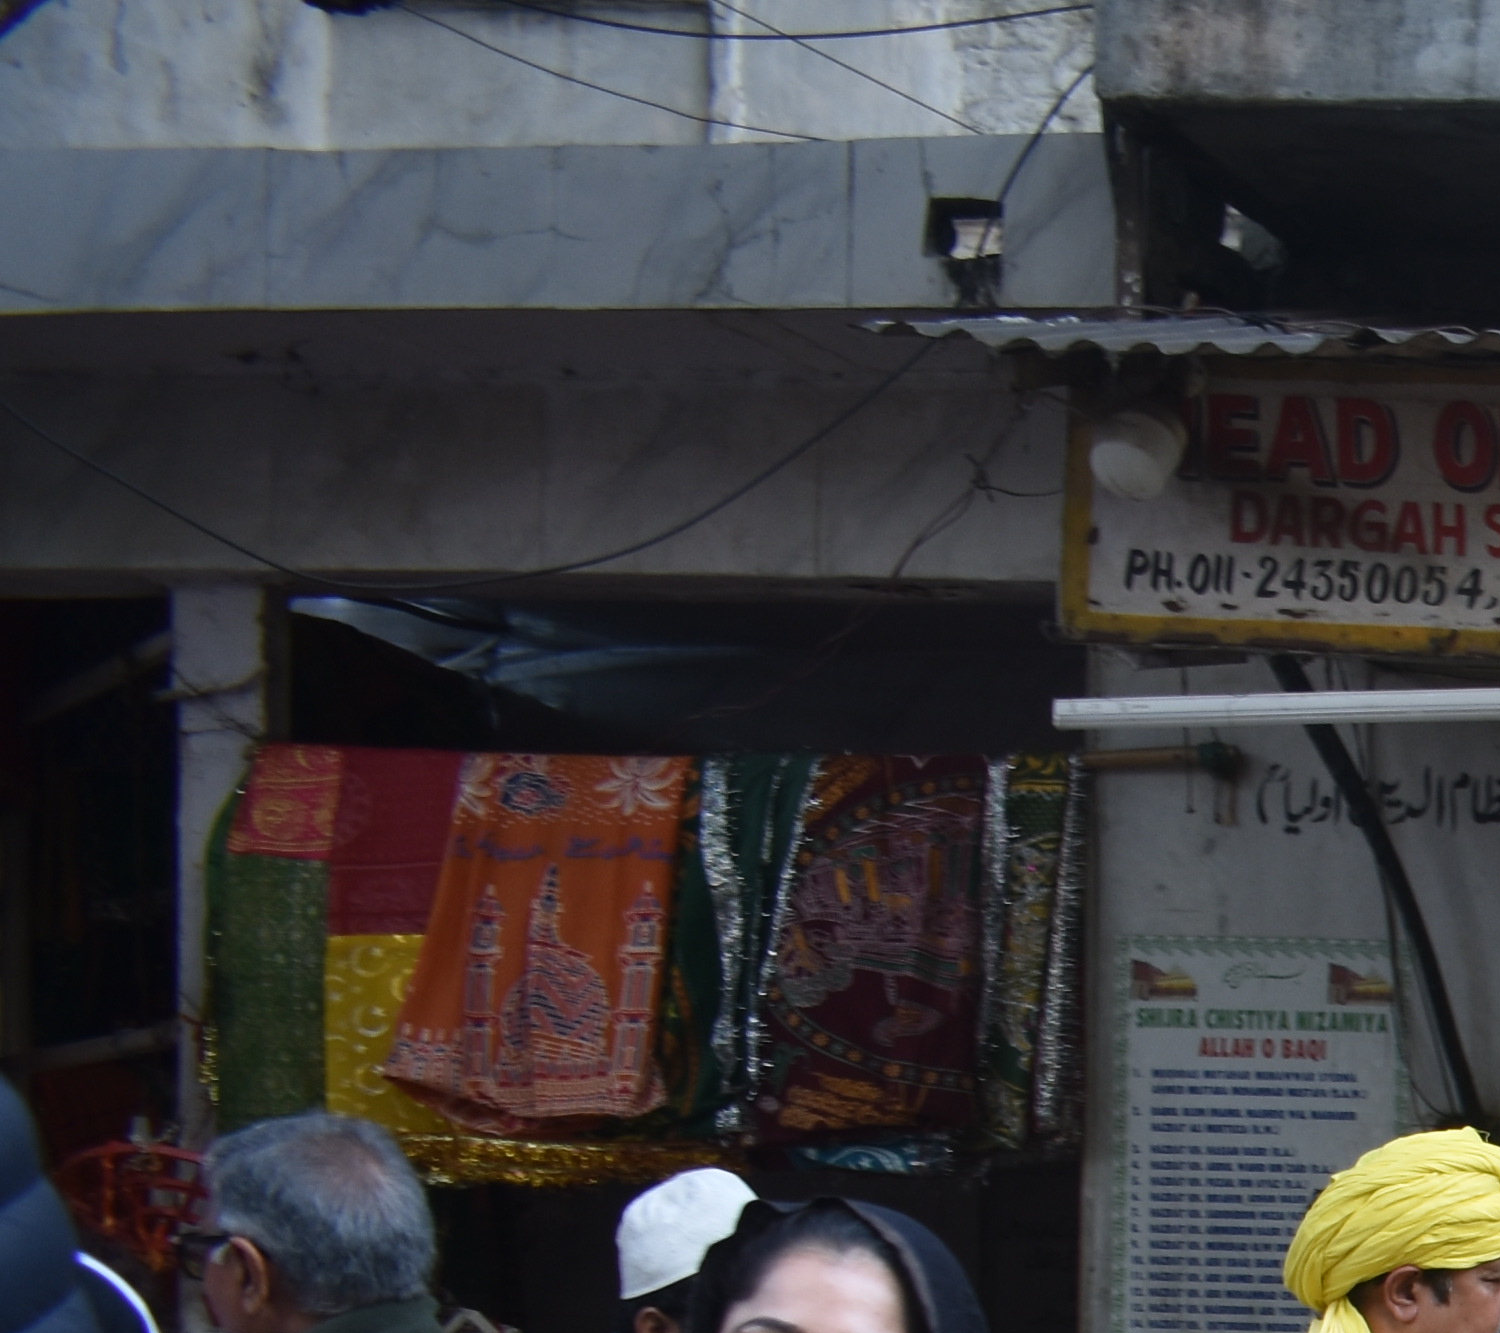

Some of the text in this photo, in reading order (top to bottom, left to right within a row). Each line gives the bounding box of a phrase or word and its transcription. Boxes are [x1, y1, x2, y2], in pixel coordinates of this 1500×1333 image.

[1231, 490, 1466, 556] DARGAH
[1199, 1037, 1255, 1058] ALLAH
[1261, 1038, 1275, 1059] O
